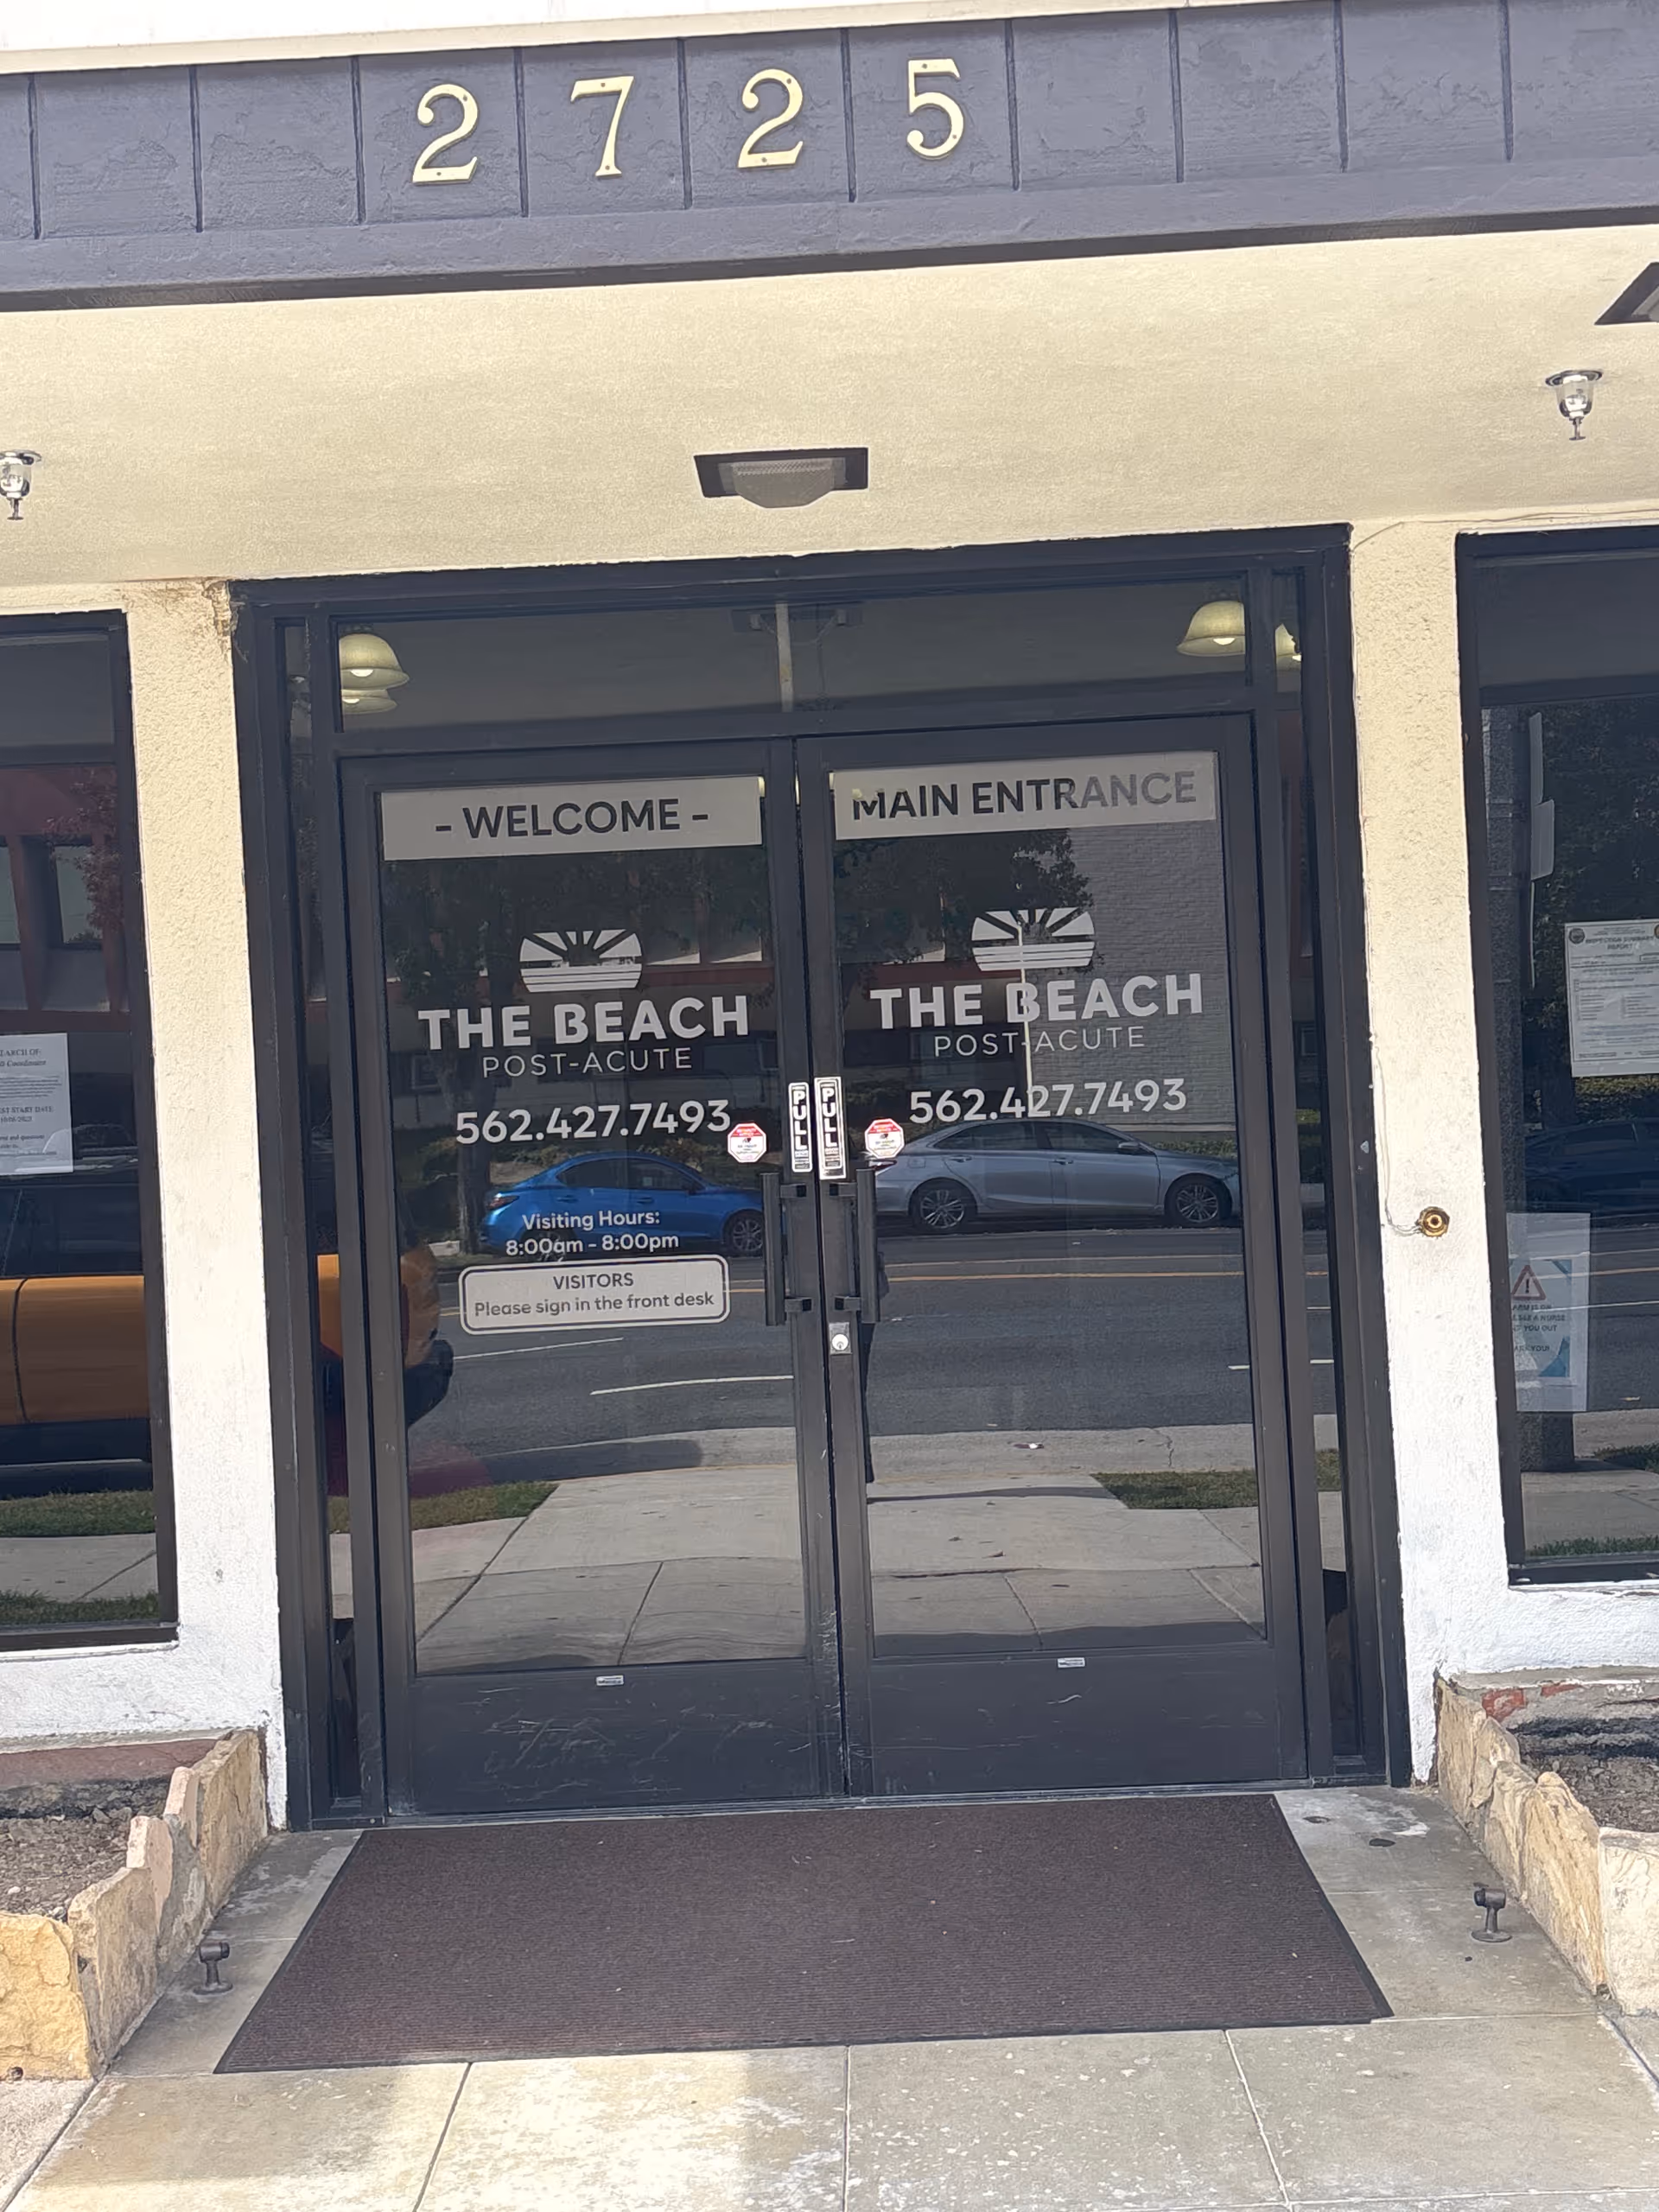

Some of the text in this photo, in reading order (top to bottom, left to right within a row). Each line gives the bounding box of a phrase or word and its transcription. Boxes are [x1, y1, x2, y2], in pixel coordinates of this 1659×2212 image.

[412, 58, 964, 184] 2725
[462, 798, 681, 840] WELCOME
[852, 771, 1196, 822] MAIN ENTRANCE
[418, 995, 749, 1050] THE BEACH
[869, 973, 1203, 1030] THE BEACH
[482, 1047, 692, 1078] POST-ACUTE
[934, 1026, 1145, 1058] POST-ACUTE
[456, 1099, 731, 1145] 562.427.7493
[792, 1090, 808, 1151] PULL
[822, 1087, 838, 1147] PULL
[909, 1078, 1187, 1124] 562.427.7493
[522, 1210, 660, 1231] Visiting Hours:
[505, 1238, 583, 1256] 8:00am
[601, 1234, 679, 1253] 8:00pm
[553, 1272, 634, 1290] VISITORS
[474, 1291, 715, 1318] Please sign in the front desk
